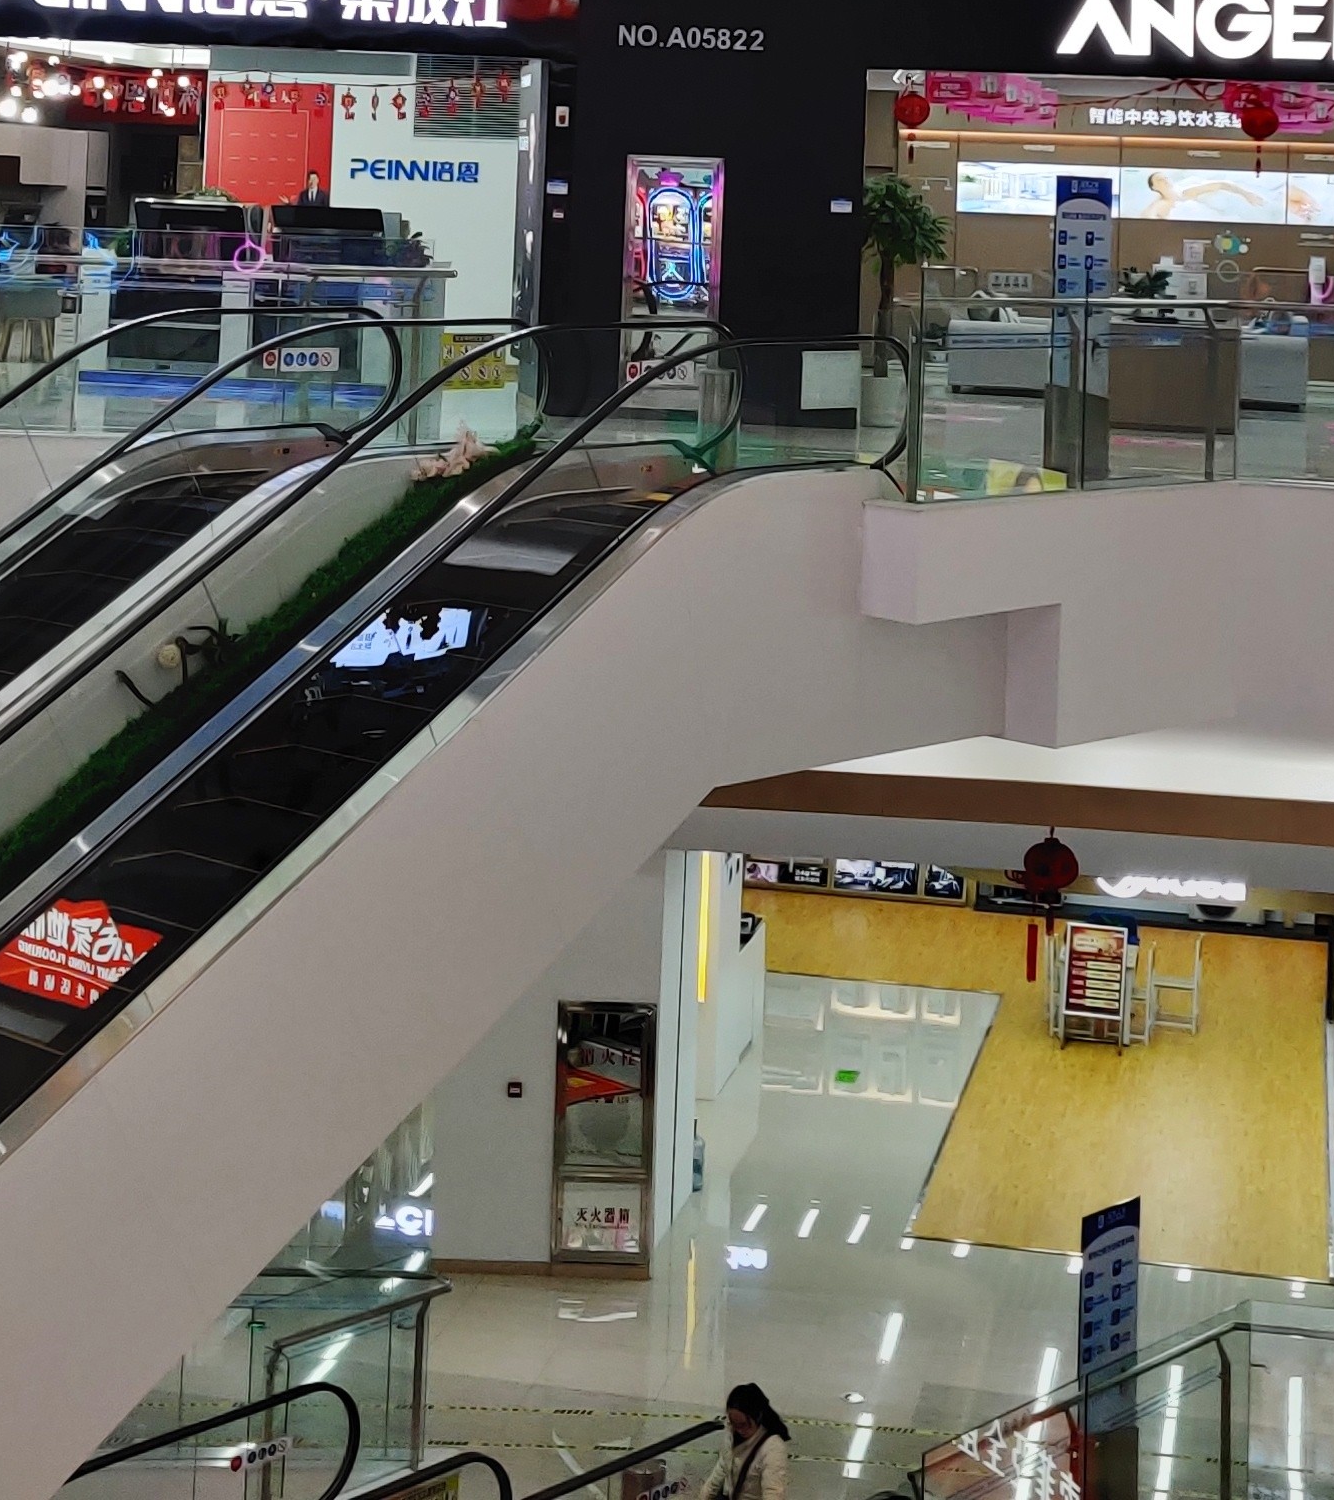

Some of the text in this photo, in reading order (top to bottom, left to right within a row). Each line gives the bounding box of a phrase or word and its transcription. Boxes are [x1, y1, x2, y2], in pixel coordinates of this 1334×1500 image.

[618, 24, 765, 51] NO.A05822
[576, 1206, 630, 1224] 灭火器箱
